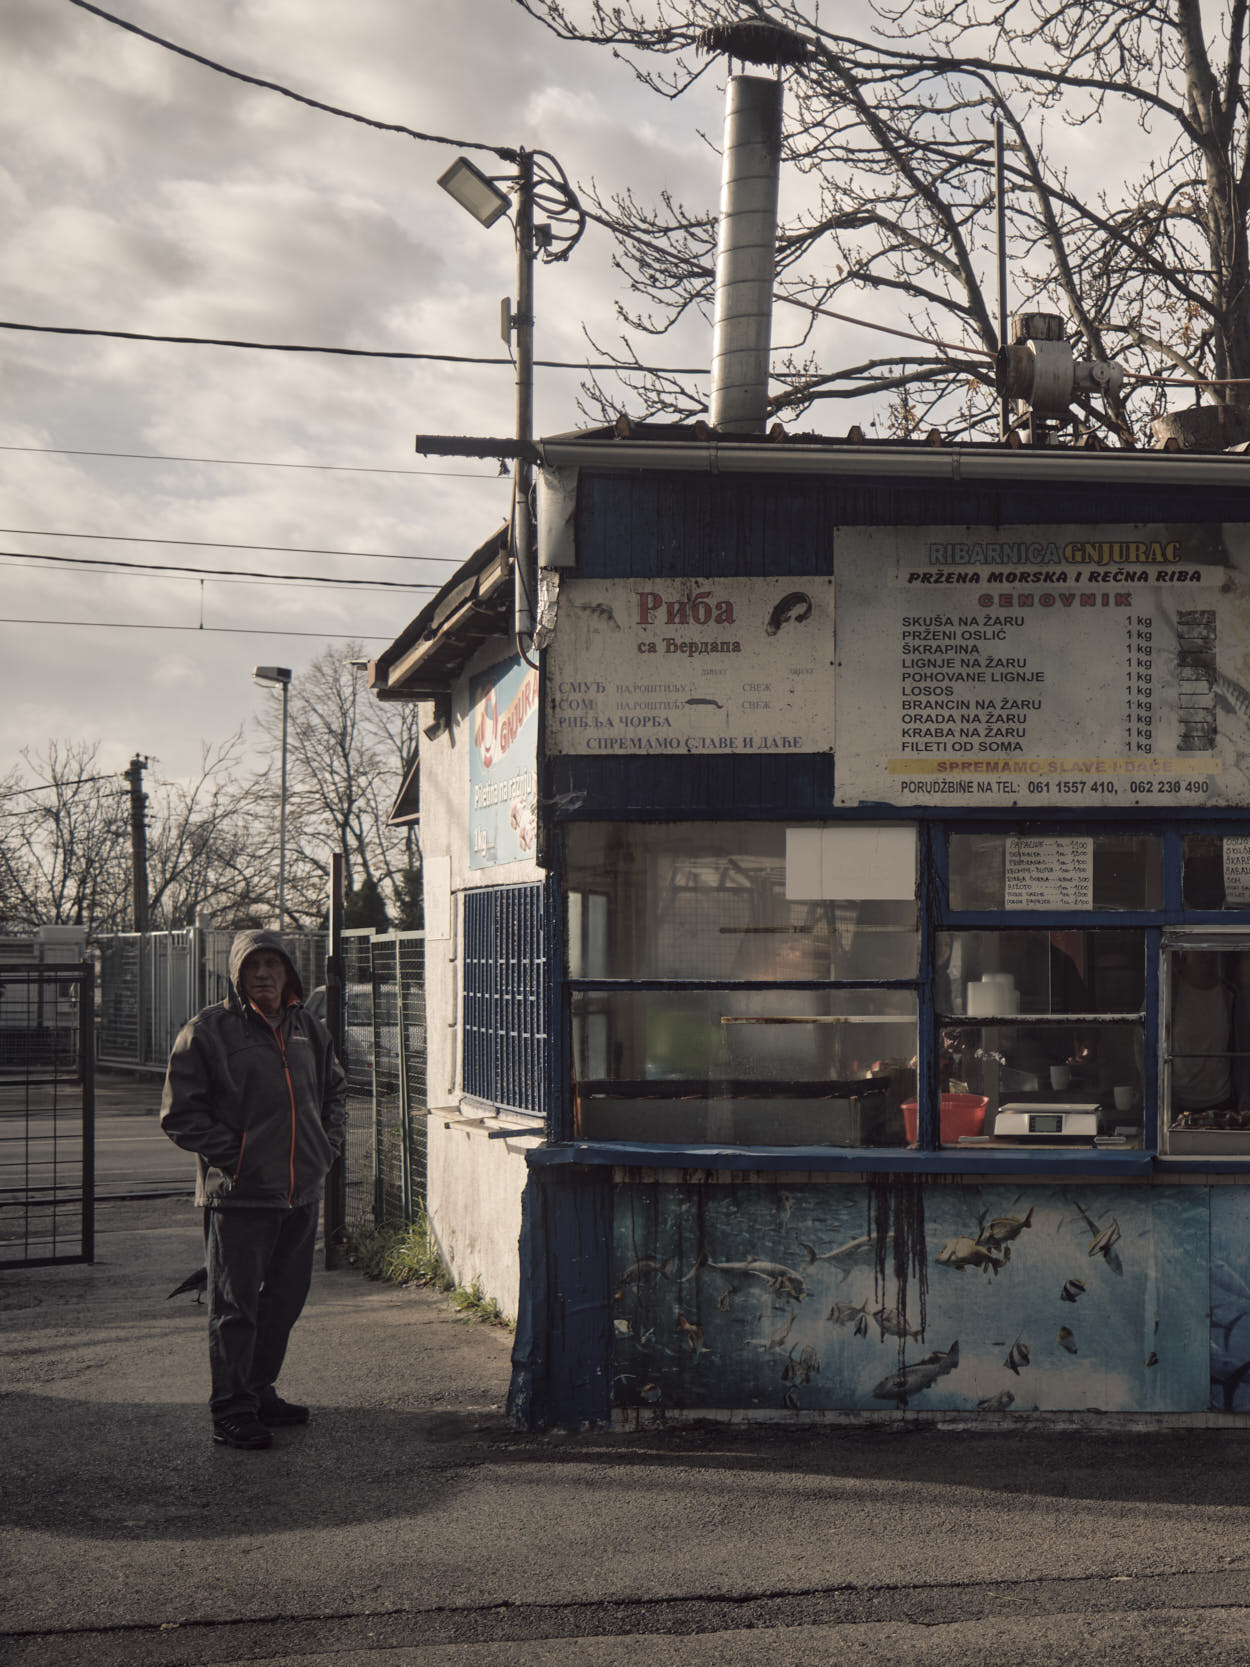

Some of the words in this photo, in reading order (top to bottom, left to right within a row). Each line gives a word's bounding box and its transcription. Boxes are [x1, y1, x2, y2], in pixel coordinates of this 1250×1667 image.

[929, 543, 1060, 565] RIBARNICA
[1064, 541, 1183, 566] GNJURAC
[908, 569, 980, 584] PRŽENA
[987, 572, 1068, 583] MORSKA
[1075, 573, 1082, 583] I
[1088, 568, 1149, 583] REČNA
[1156, 571, 1202, 582] RIBA
[978, 593, 1132, 608] CENOVNIK
[636, 591, 736, 625] Риба
[902, 614, 954, 627] SKUŠA
[958, 617, 979, 627] NA
[983, 613, 1025, 627] ŽARU
[902, 628, 957, 641] PRŽENI
[638, 642, 657, 654] са
[902, 642, 979, 655] ŠKRAPINA
[902, 658, 956, 669] LIGNJE
[960, 658, 982, 668] NA
[985, 655, 1026, 669] ŽARU
[902, 672, 986, 682] POHOVANE
[991, 672, 1044, 682] LIGNJE
[559, 681, 606, 694] СМУЂ
[902, 686, 954, 697] LOSOS
[559, 698, 594, 711] СОМ
[902, 700, 971, 710] BRANCIN
[975, 700, 997, 710] NA
[1000, 697, 1042, 710] ŽARU
[619, 717, 672, 728] ЧОРБА
[902, 714, 956, 724] ORADA
[961, 714, 982, 724] NA
[985, 711, 1026, 724] ŽARU
[902, 728, 955, 738] KRABA
[960, 728, 981, 738] NA
[984, 724, 1026, 738] ŽARU
[586, 737, 681, 750] СПРЕМАМО
[685, 737, 738, 750] СЛАВЕ
[743, 737, 754, 749] И
[759, 737, 803, 750] ДАЋЕ
[902, 742, 947, 752] FILETI
[952, 741, 974, 752] OD
[978, 741, 1023, 752] SOMA
[901, 778, 975, 793] PORUDŽBINE
[978, 782, 993, 792] NA
[996, 781, 1020, 793] TEL:
[1028, 781, 1052, 793] 061
[1056, 781, 1086, 793] 1557
[1091, 781, 1118, 796] 410,
[1130, 781, 1153, 793] 062
[1158, 781, 1181, 793] 230
[1185, 781, 1209, 793] 490
